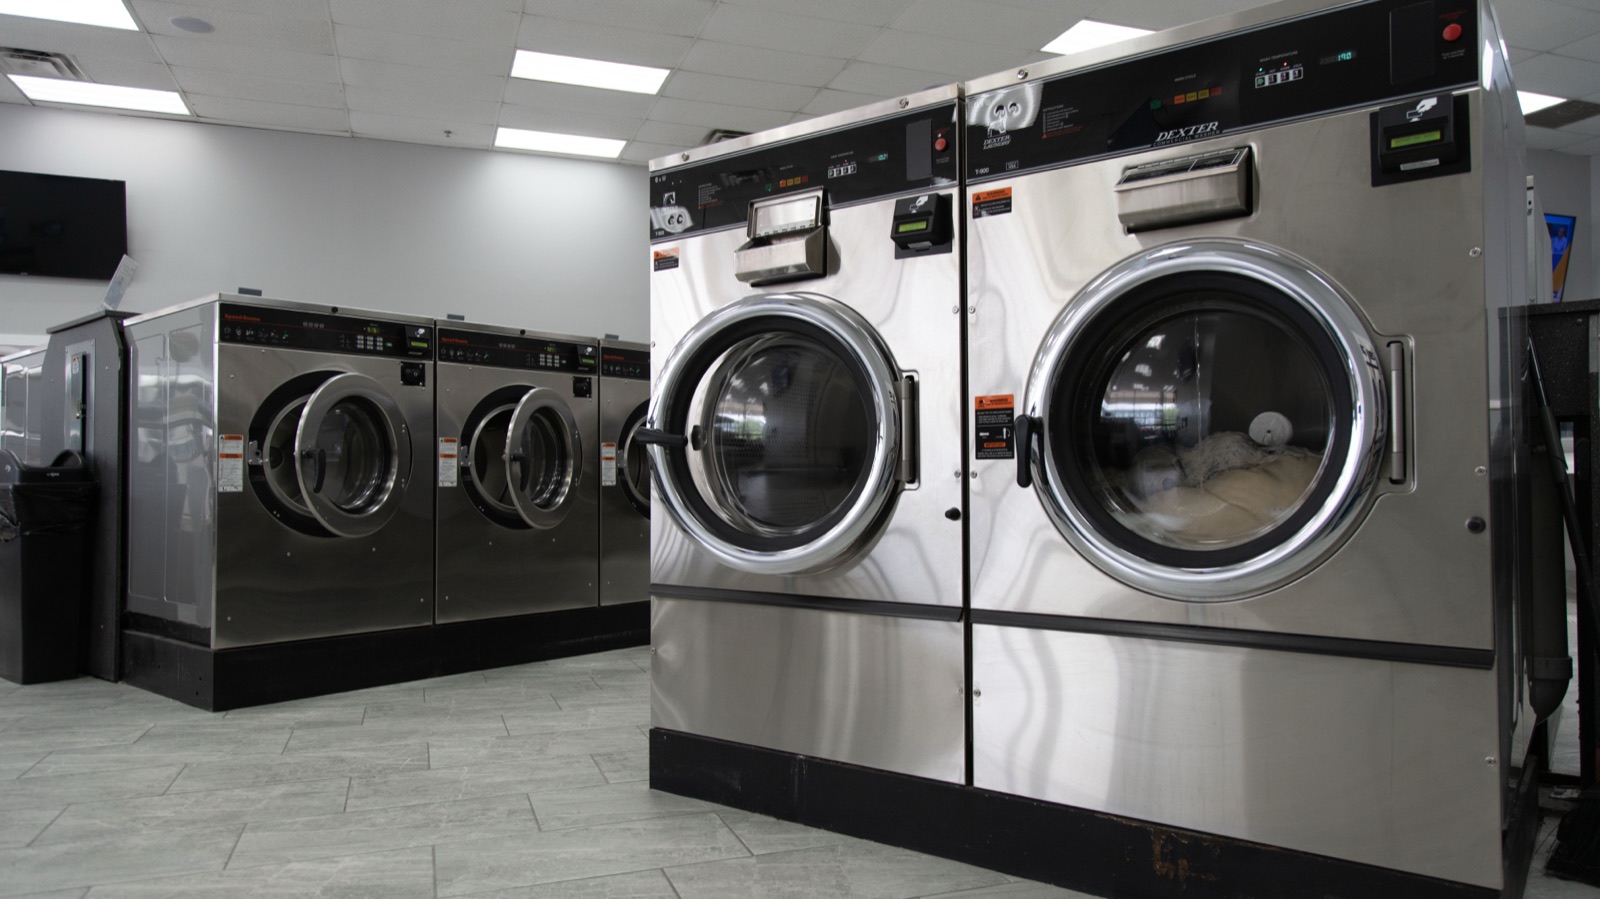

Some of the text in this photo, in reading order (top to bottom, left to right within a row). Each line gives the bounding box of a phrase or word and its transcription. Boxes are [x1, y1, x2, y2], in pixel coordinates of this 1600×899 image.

[1155, 121, 1219, 142] DEXTER
[983, 134, 1011, 145] DEXTER
[1153, 129, 1220, 147] COMMERCIAL WASHER
[983, 139, 1011, 150] LAUNDRY
[975, 167, 990, 175] T-900
